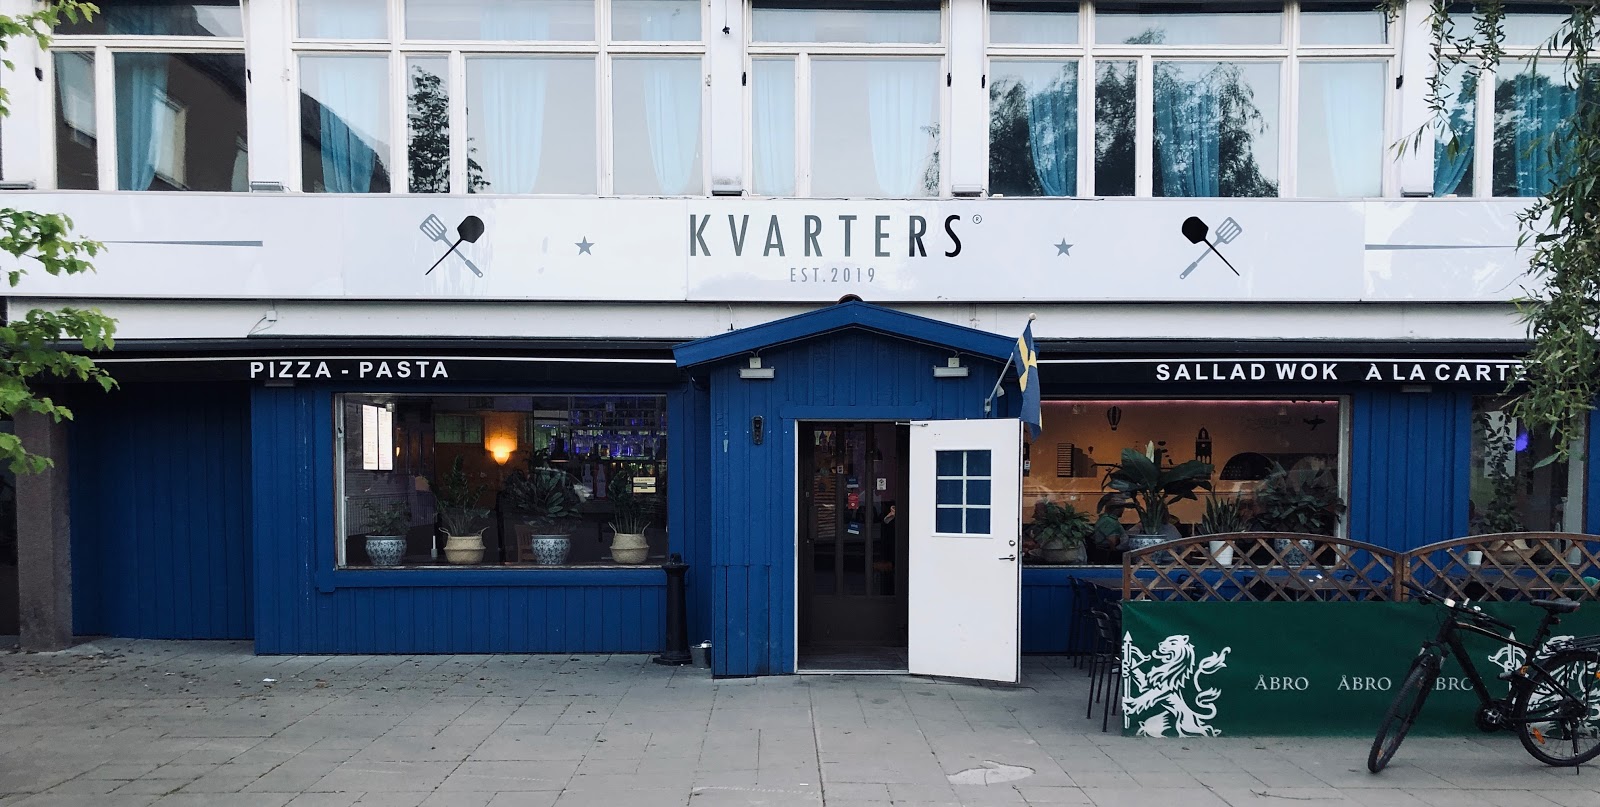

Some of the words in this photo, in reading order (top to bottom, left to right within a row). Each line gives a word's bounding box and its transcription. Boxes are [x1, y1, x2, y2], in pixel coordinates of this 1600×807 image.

[690, 214, 962, 258] KVARTERS
[790, 267, 875, 283] EST.2019
[250, 361, 332, 379] PIZZA
[359, 361, 449, 379] PASTA
[1156, 363, 1266, 381] SALLAD
[1275, 363, 1338, 381] WOK
[1365, 362, 1383, 381] À
[1393, 363, 1426, 381] LA
[1255, 674, 1309, 691] ÅBRO
[1338, 674, 1392, 691] ÅBRO
[1431, 676, 1474, 691] BRO
